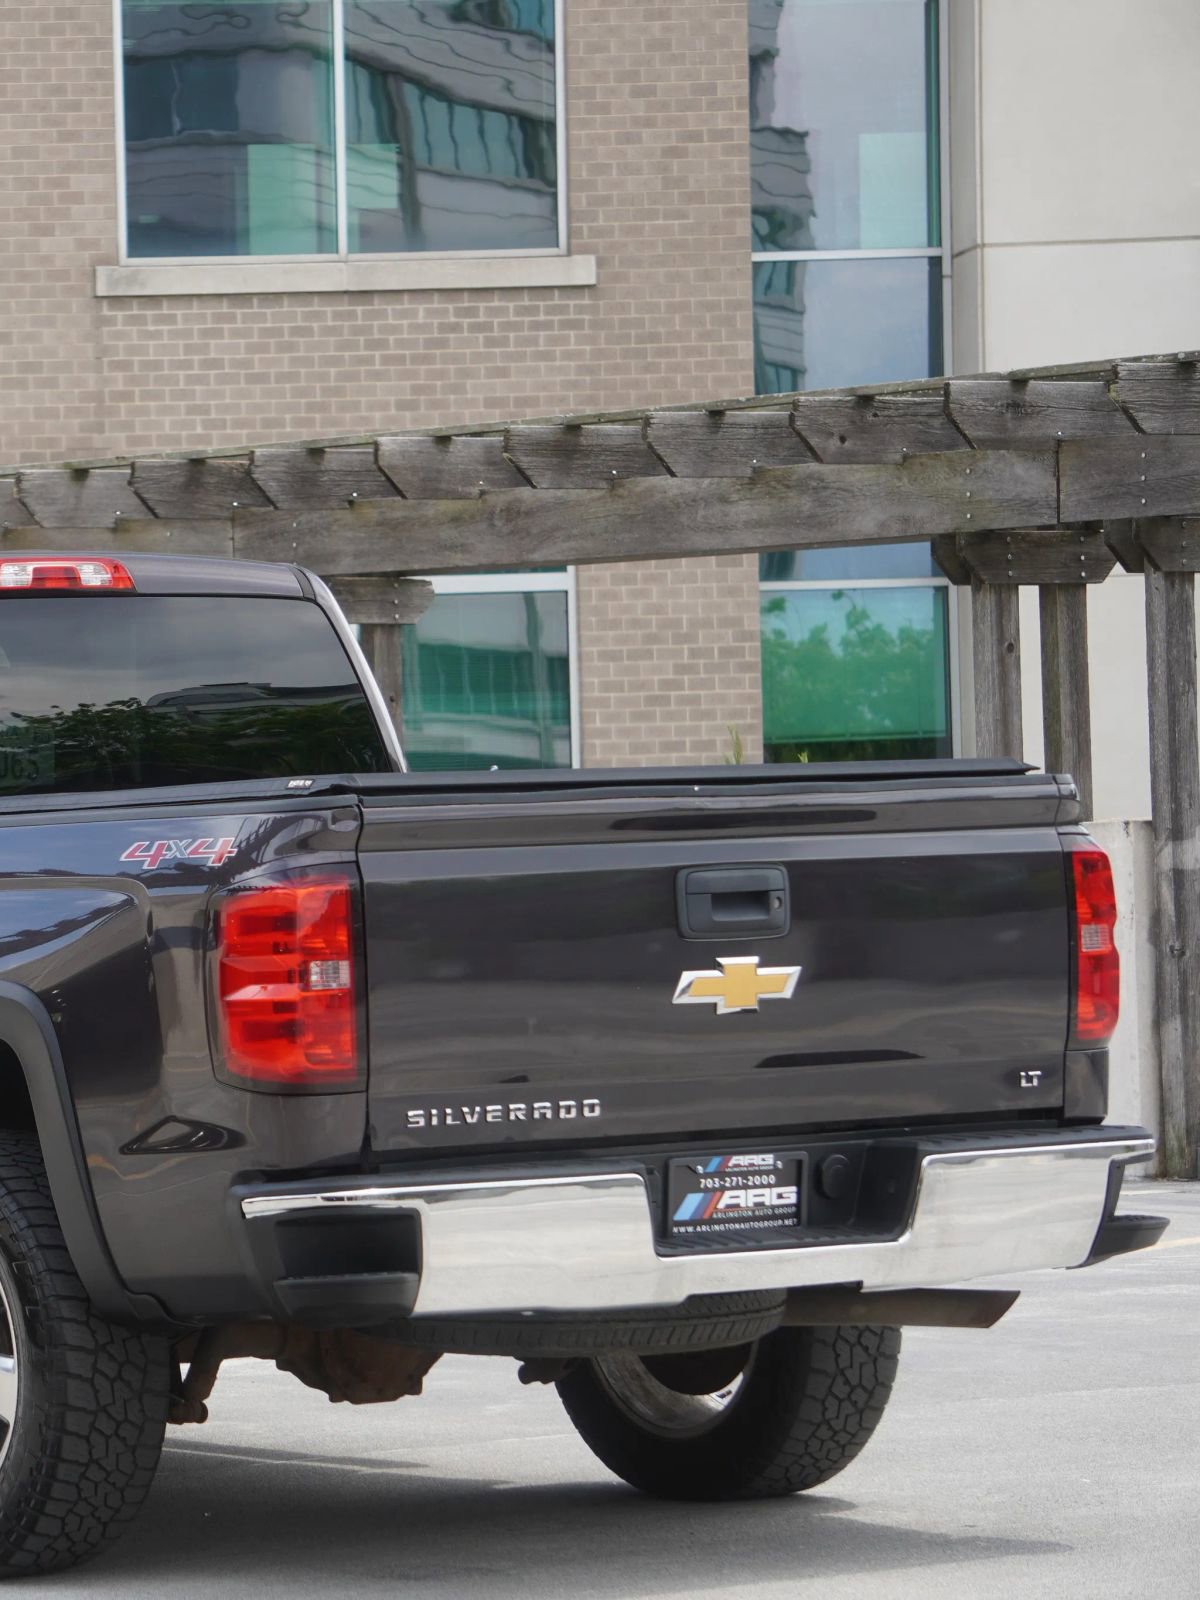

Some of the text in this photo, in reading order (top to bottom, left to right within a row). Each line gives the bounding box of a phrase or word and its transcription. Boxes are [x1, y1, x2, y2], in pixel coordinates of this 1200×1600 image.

[1019, 1070, 1042, 1087] LT
[406, 1098, 601, 1128] SILVERADO
[699, 1174, 776, 1189] 703-271-2000
[711, 1206, 797, 1219] ARLINGTON AUTO GROUP
